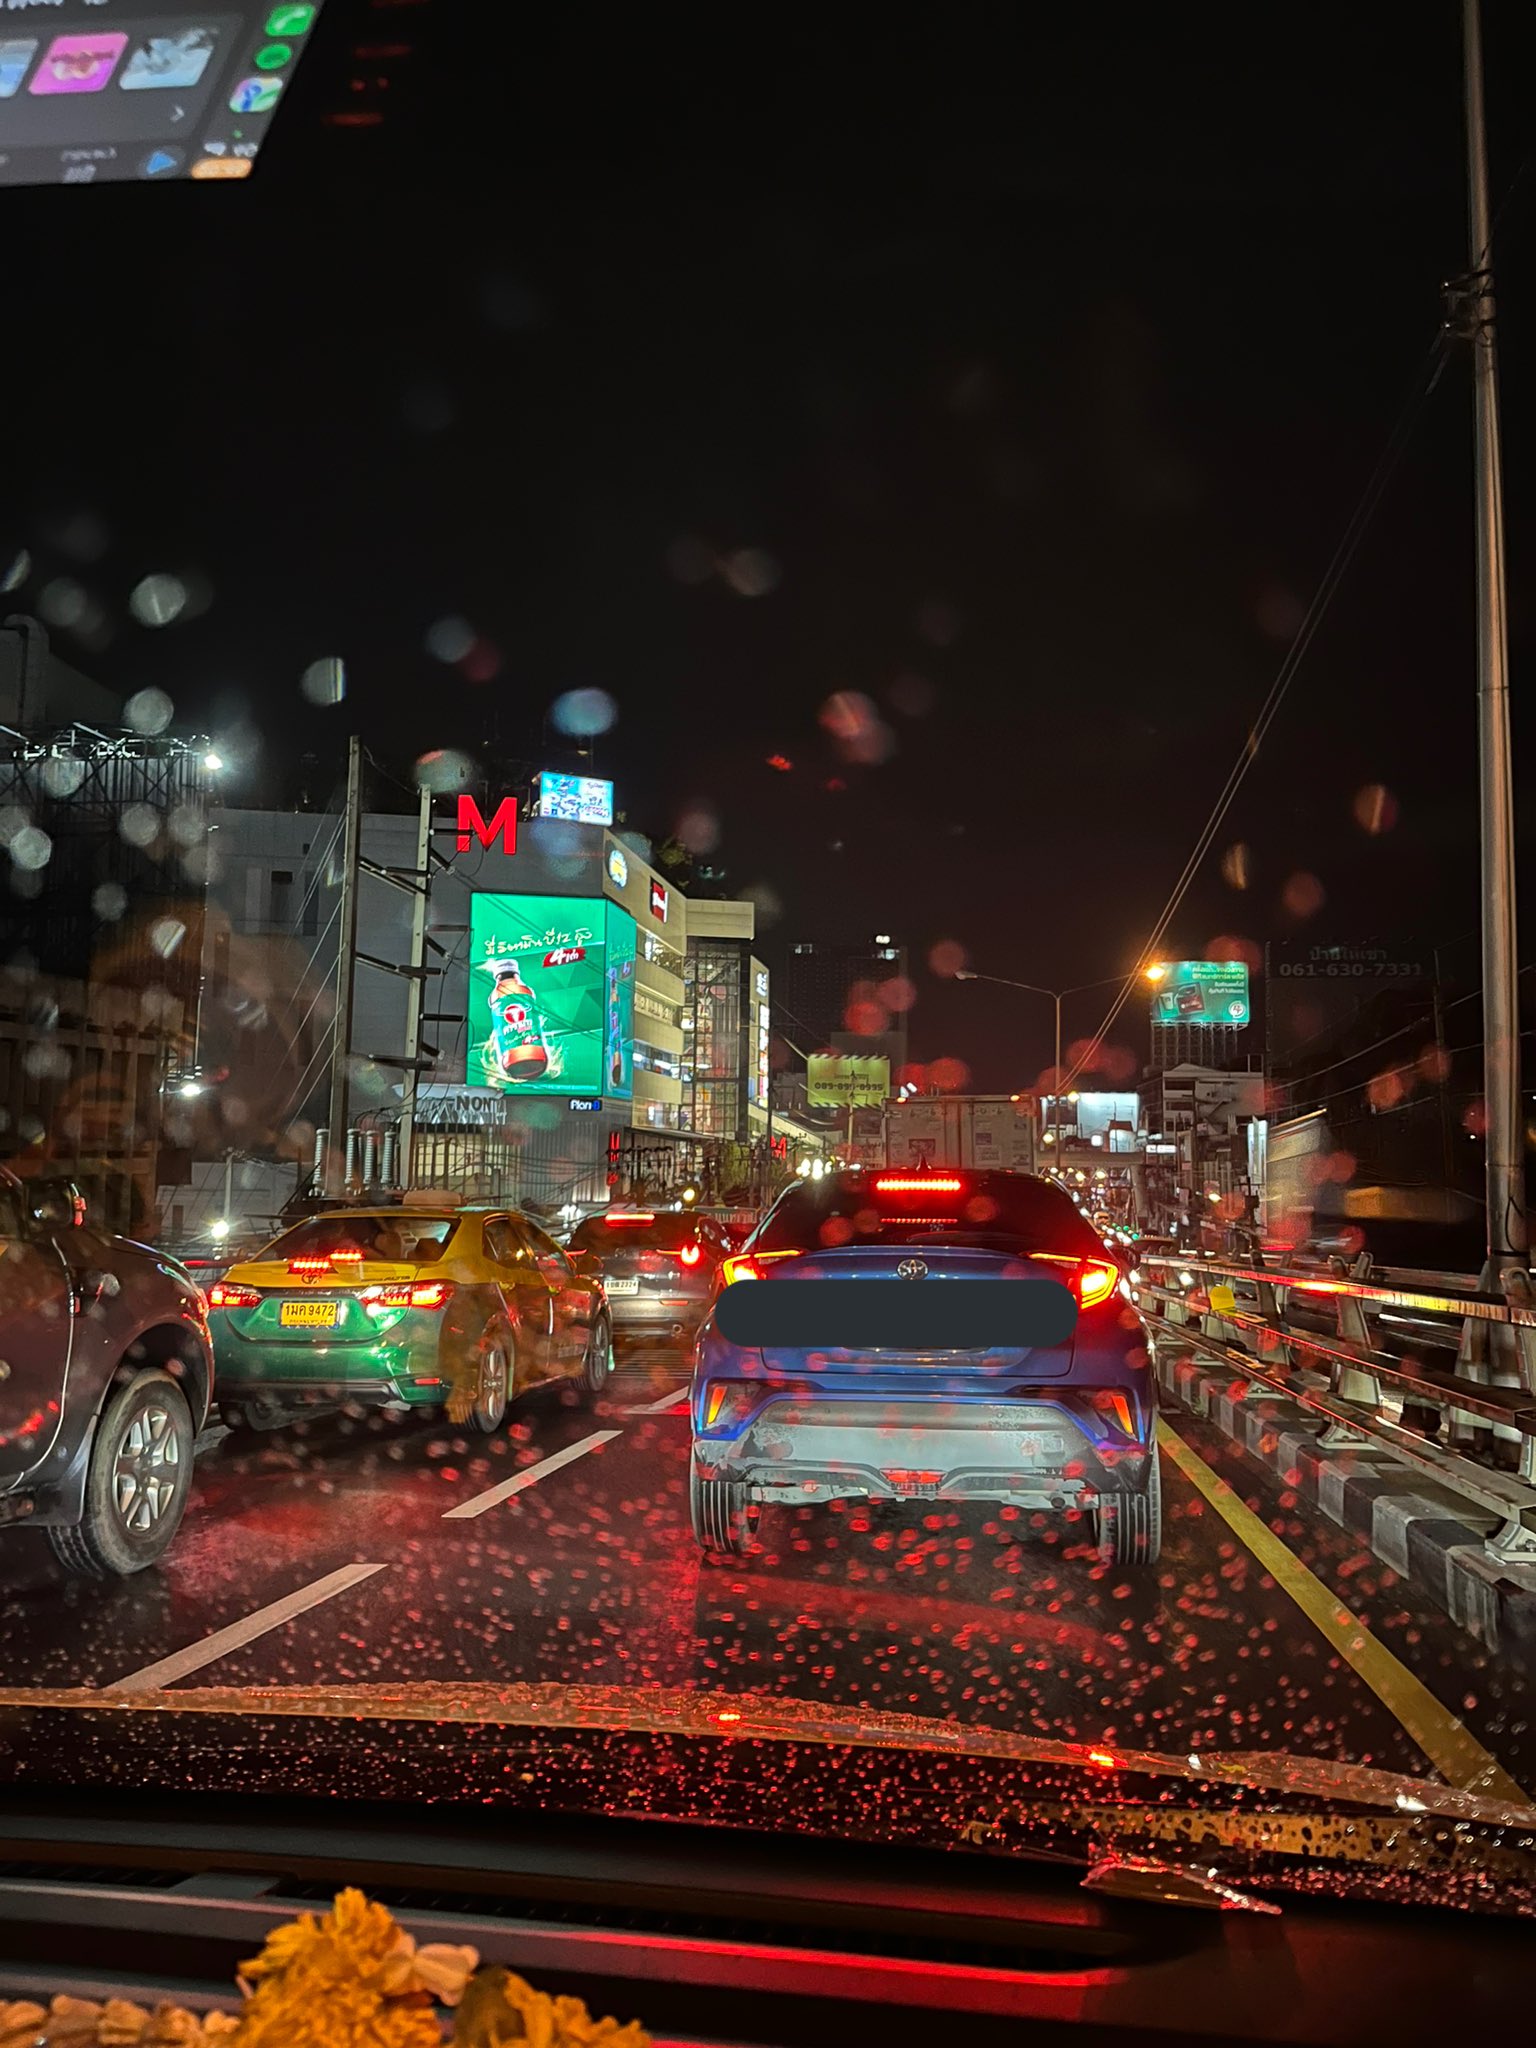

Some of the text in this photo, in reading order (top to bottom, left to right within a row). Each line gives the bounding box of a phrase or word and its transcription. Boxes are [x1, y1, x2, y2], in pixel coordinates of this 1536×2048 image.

[457, 794, 518, 855] M
[1279, 963, 1422, 976] 061-630-7331
[308, 1304, 335, 1317] 9472
